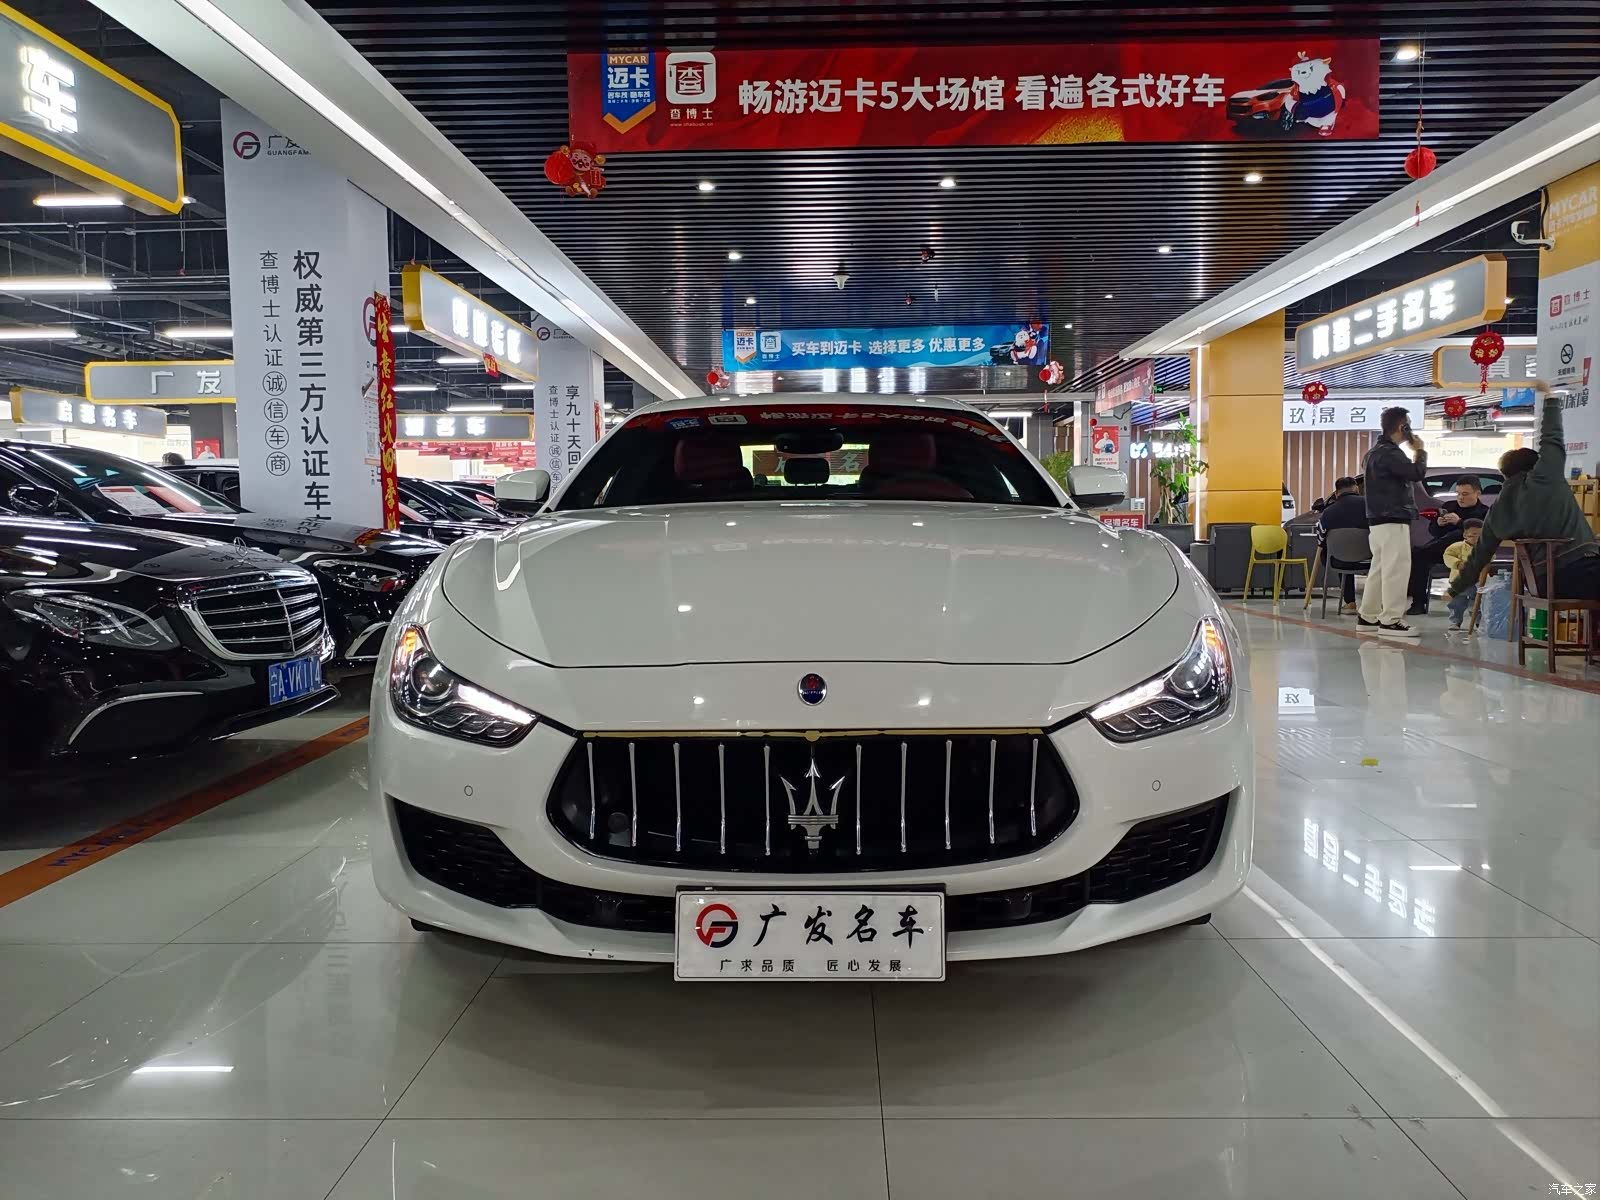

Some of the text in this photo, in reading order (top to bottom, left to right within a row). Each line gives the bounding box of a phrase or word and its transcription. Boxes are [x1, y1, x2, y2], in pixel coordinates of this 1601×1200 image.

[609, 55, 647, 64] MYCAR
[20, 45, 78, 134] 车
[607, 66, 650, 89] 迈卡
[738, 73, 1226, 115] 畅游迈卡5大场馆 看遍各式好车
[670, 108, 713, 120] 查博士
[792, 336, 986, 357] 买车到迈卡 选择更多 优惠更多
[259, 250, 290, 477] 查博士认证诚信车商
[292, 250, 332, 520] 权威第三方认证车
[566, 385, 582, 474] 享九十天回
[1289, 406, 1389, 424] 玖晟名
[753, 903, 924, 949] 广发名车
[719, 959, 902, 972] 广求品质 匠心发展
